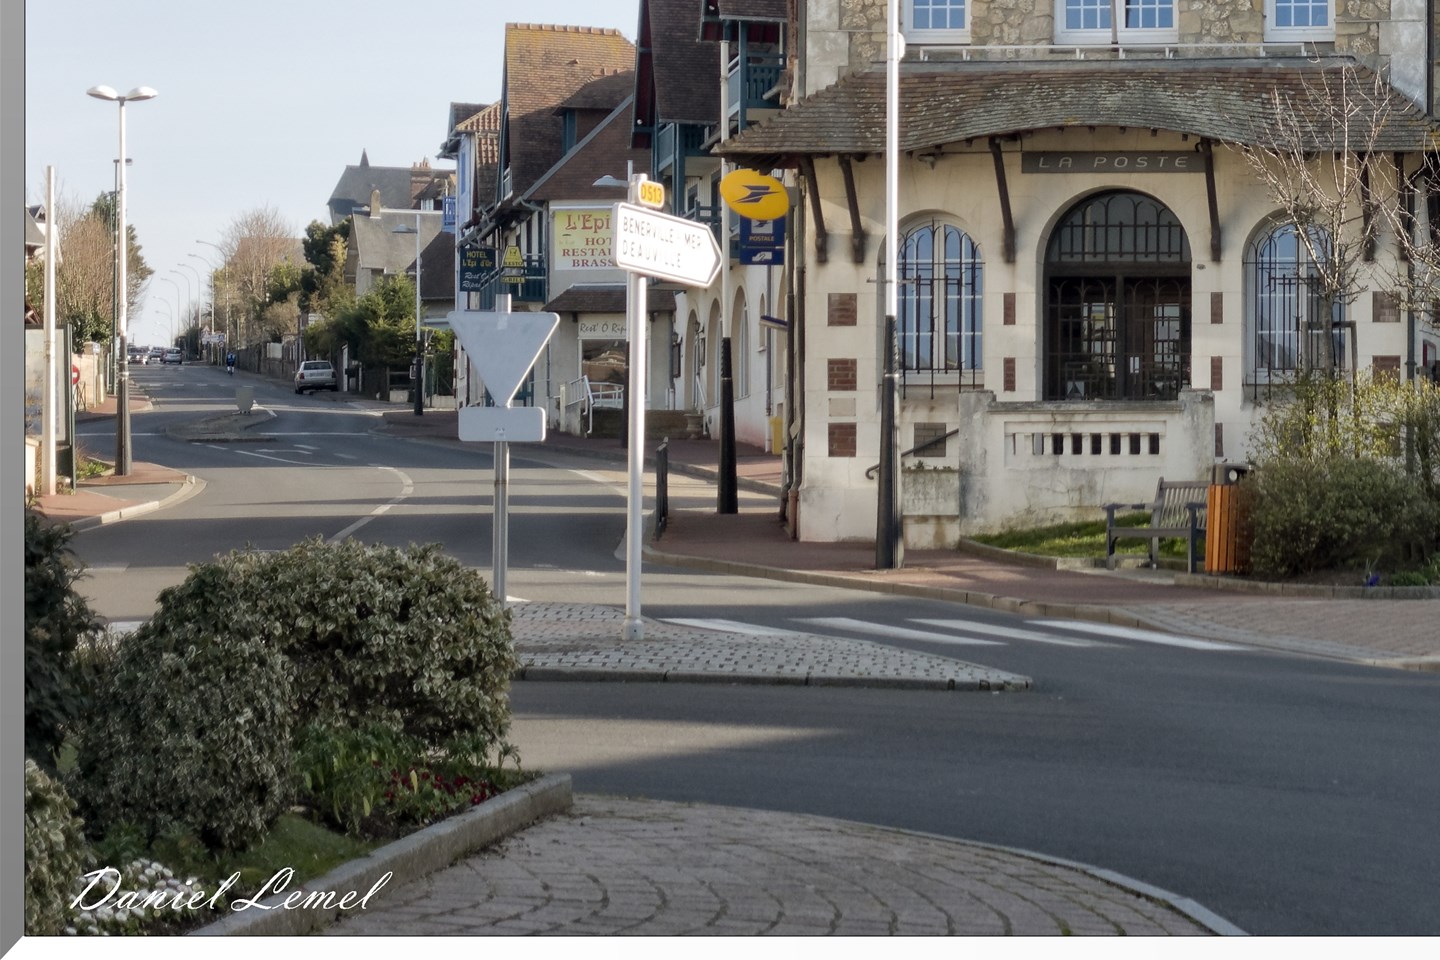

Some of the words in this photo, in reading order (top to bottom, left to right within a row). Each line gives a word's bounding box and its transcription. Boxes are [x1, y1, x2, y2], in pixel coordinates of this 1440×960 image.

[1039, 156, 1072, 169] LA
[1093, 156, 1190, 169] POSTE
[640, 183, 662, 204] D513
[585, 237, 612, 246] HOT
[562, 248, 612, 257] RESTA
[572, 259, 614, 267] BRASS
